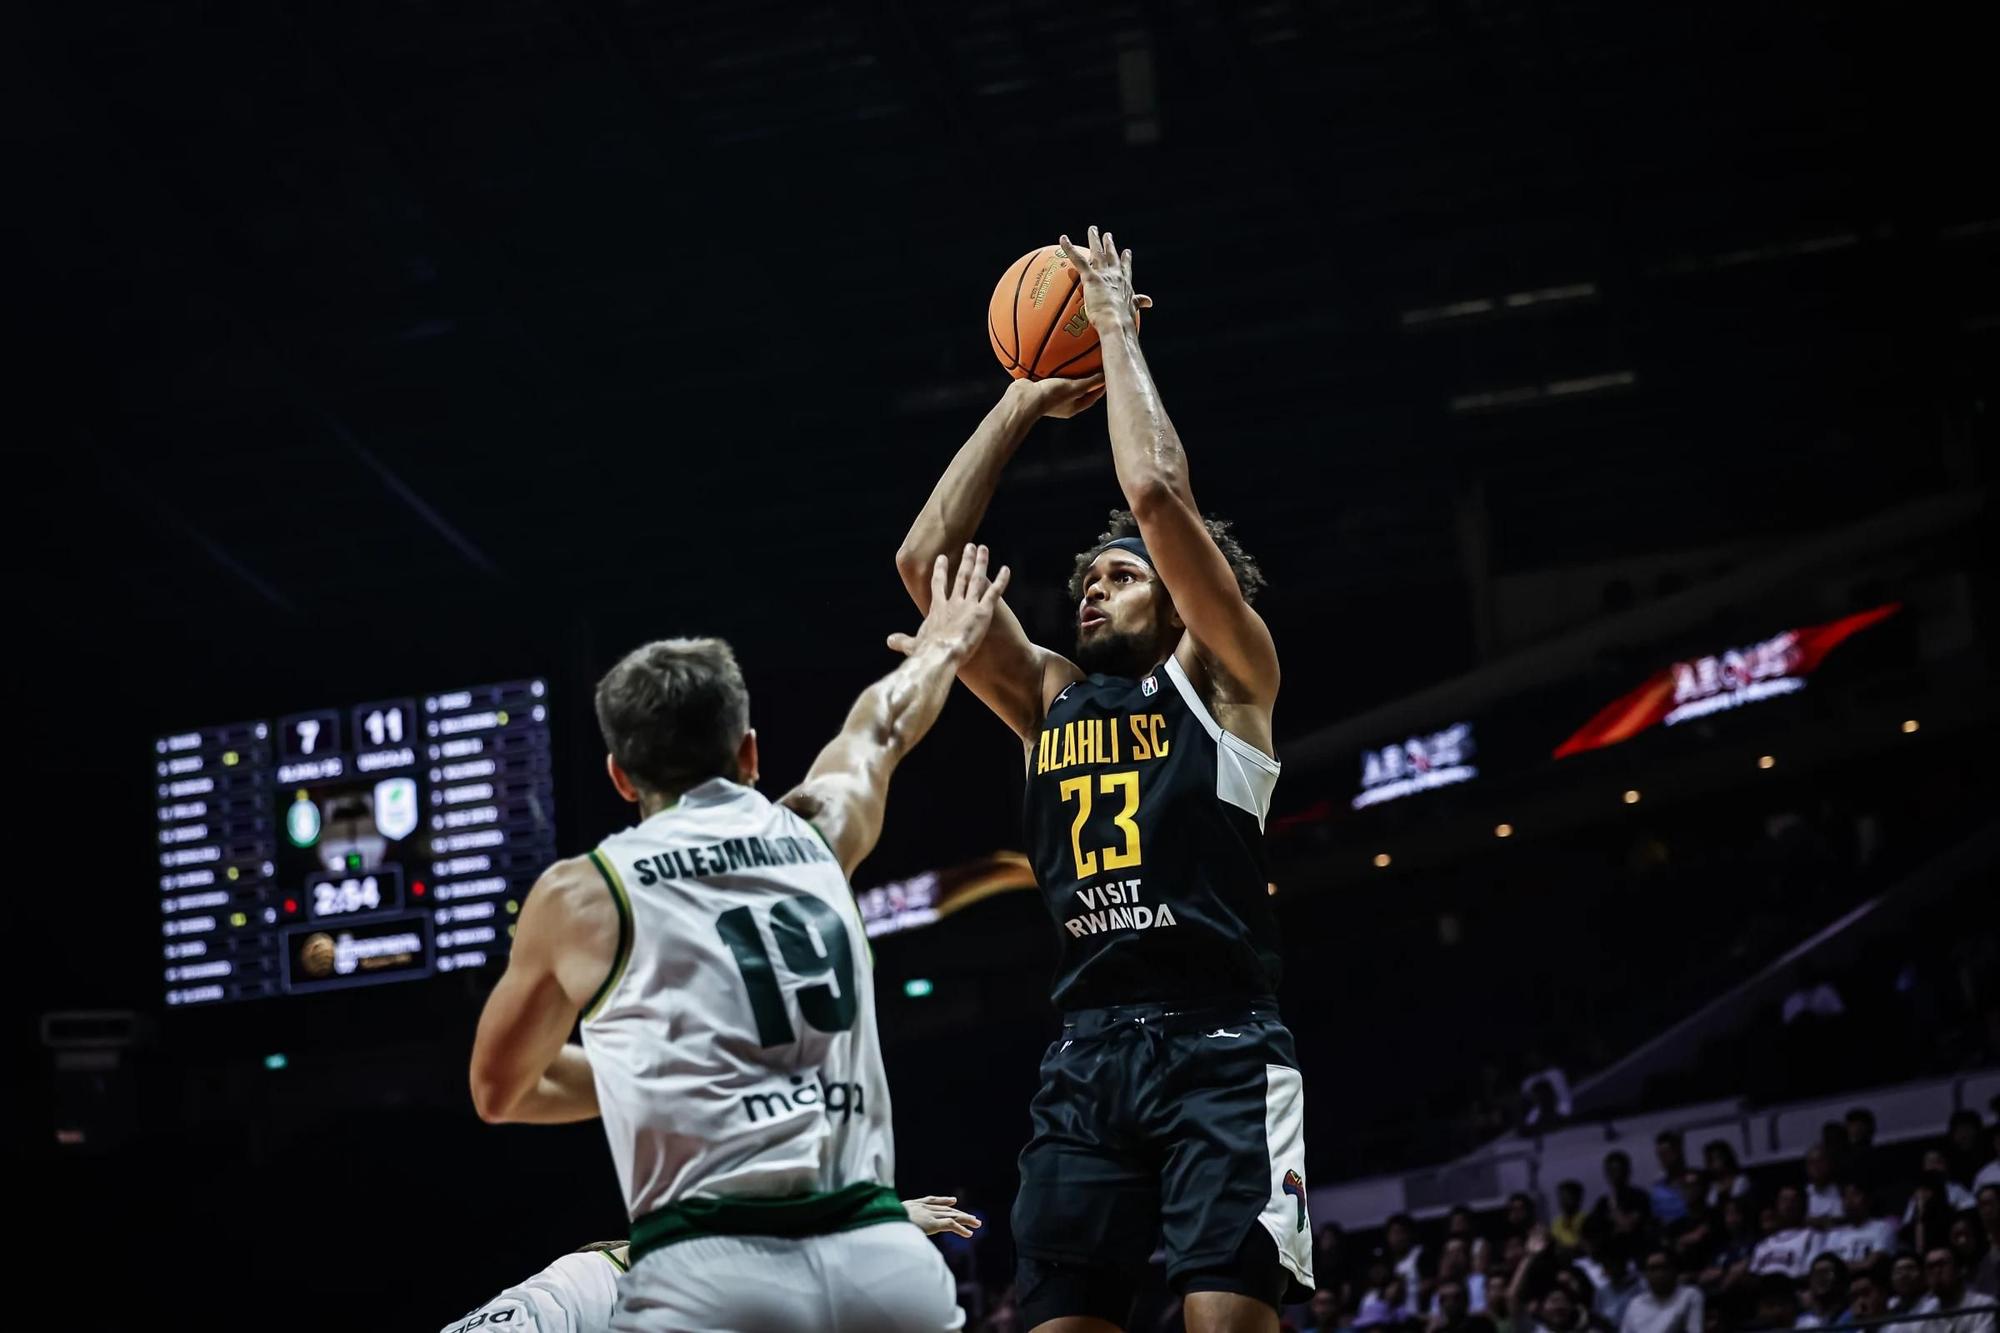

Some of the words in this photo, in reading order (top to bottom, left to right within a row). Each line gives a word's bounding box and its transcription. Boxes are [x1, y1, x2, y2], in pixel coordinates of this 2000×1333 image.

[296, 719, 321, 755] 7
[363, 706, 403, 745] 11
[1037, 717, 1120, 775] ALAHLI
[1129, 713, 1170, 761] SC
[1059, 770, 1142, 880] 23
[1076, 878, 1142, 911] VISIT
[1064, 903, 1177, 938] RWANDA
[716, 895, 857, 1048] 19
